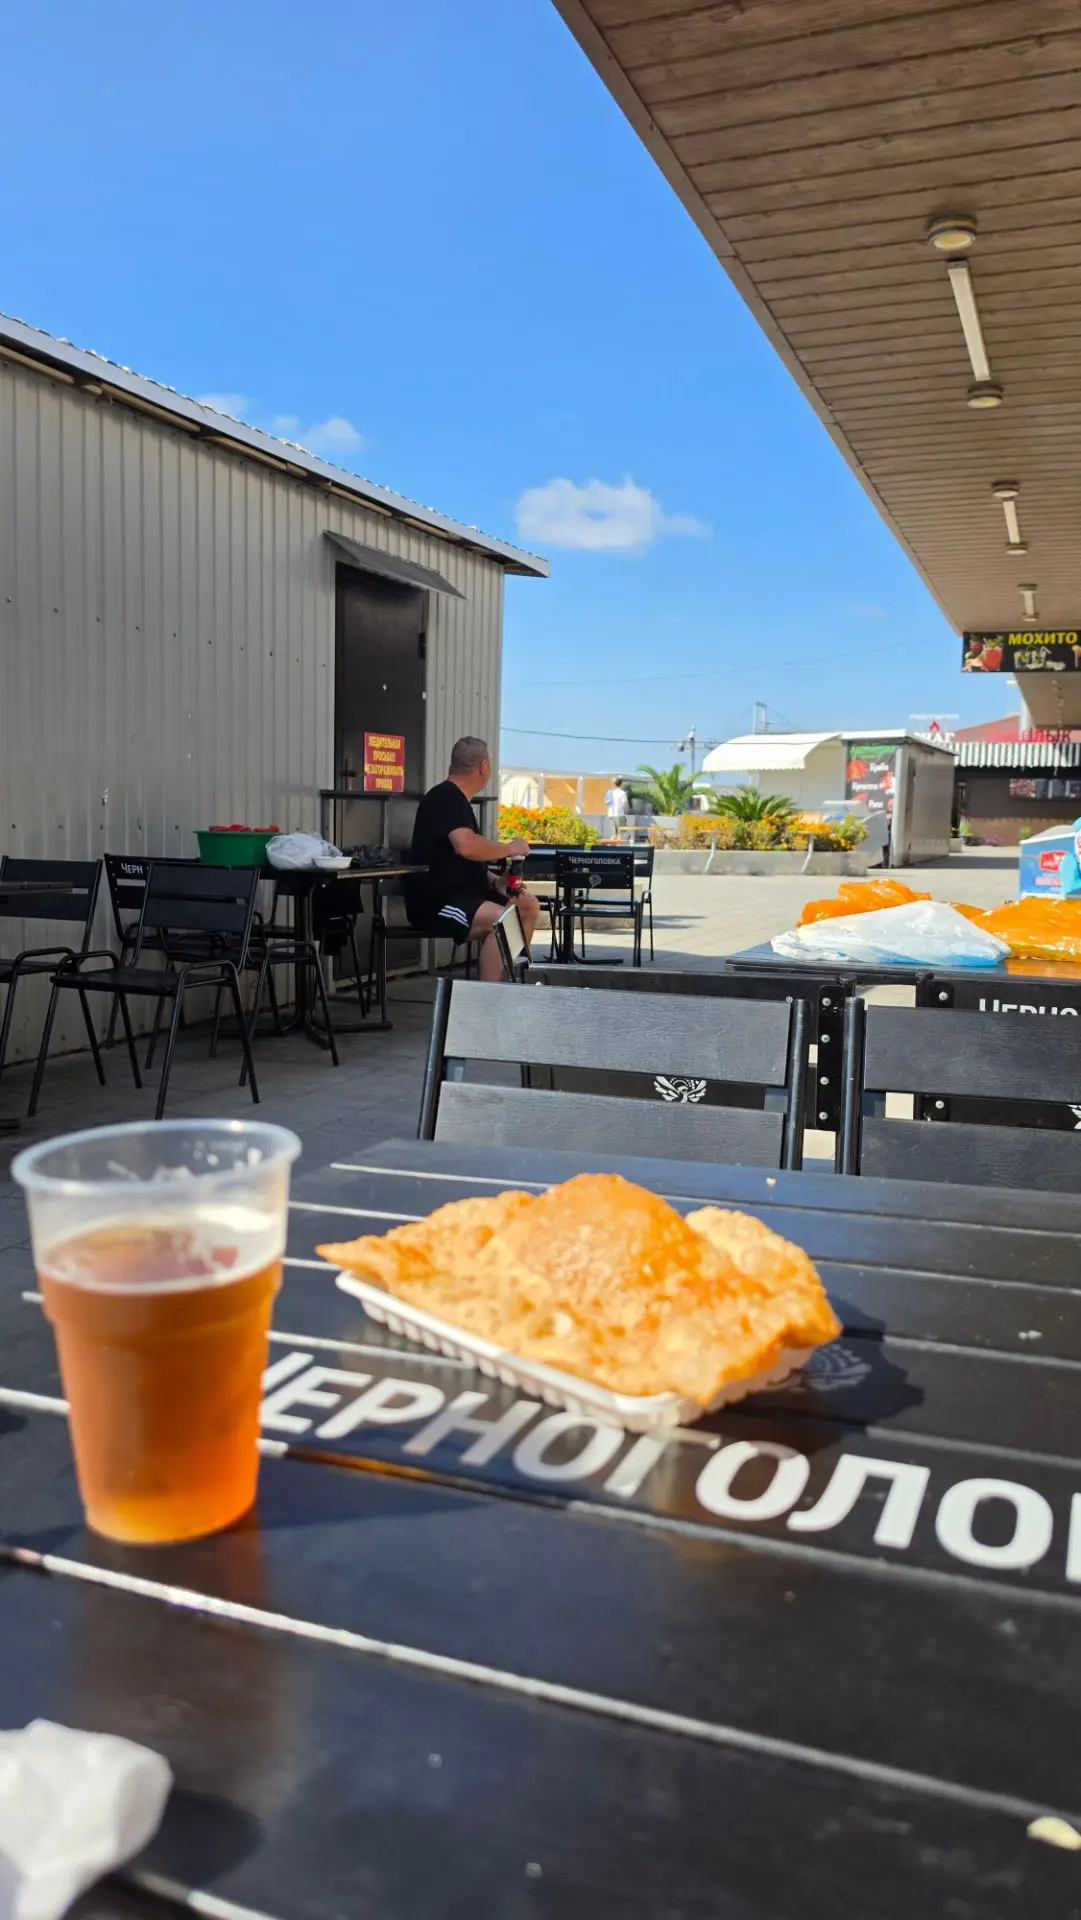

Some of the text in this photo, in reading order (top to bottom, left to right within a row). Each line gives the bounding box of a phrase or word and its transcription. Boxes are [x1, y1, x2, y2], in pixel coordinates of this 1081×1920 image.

[1008, 632, 1078, 645] МОХИТО
[568, 856, 621, 865] ЧЕРНОГОЛОВКА
[259, 1352, 1081, 1584] ЕРНОГОЛО
